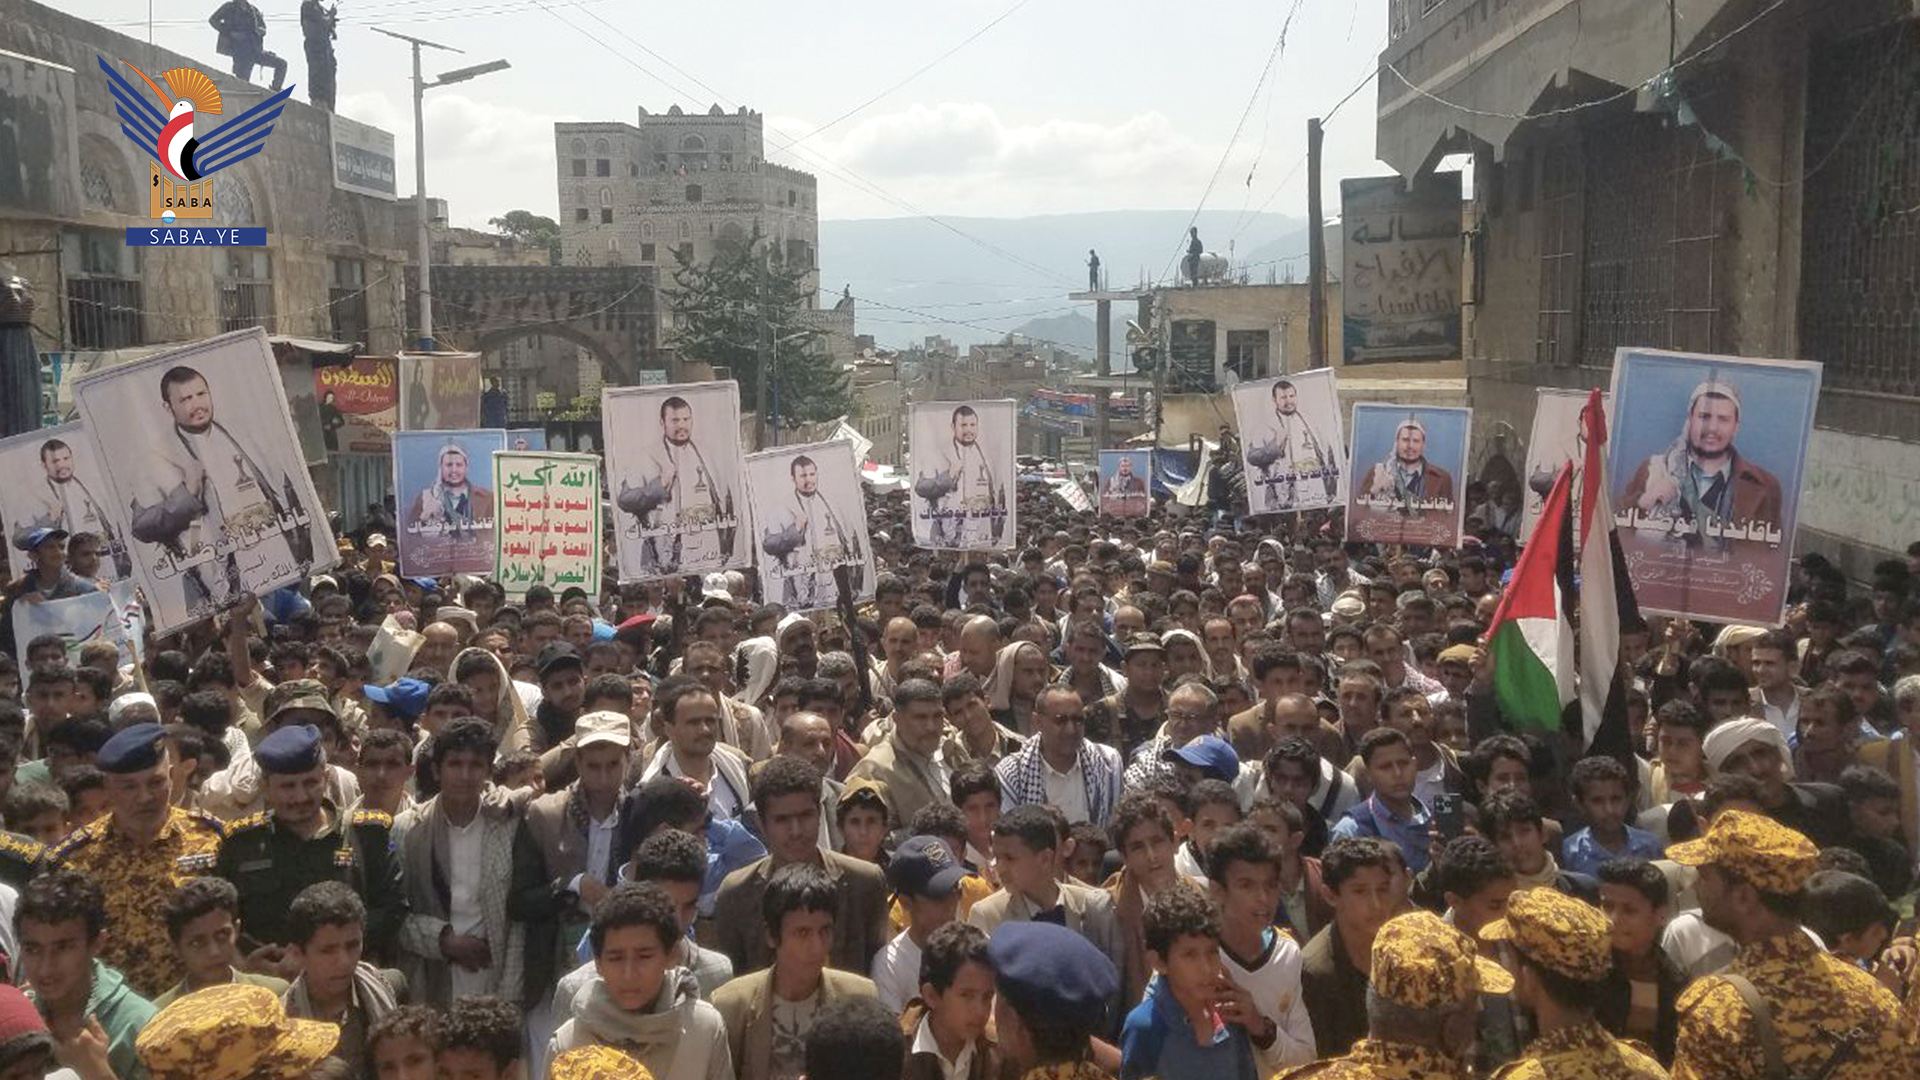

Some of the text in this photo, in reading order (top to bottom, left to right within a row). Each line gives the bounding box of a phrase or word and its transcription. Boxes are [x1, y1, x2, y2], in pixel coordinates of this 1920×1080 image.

[560, 465, 593, 488] الله
[554, 496, 593, 513] الموت
[553, 519, 593, 536] الموت
[538, 540, 558, 561] على
[562, 540, 593, 558] اللعنة
[550, 561, 593, 588] النصر
